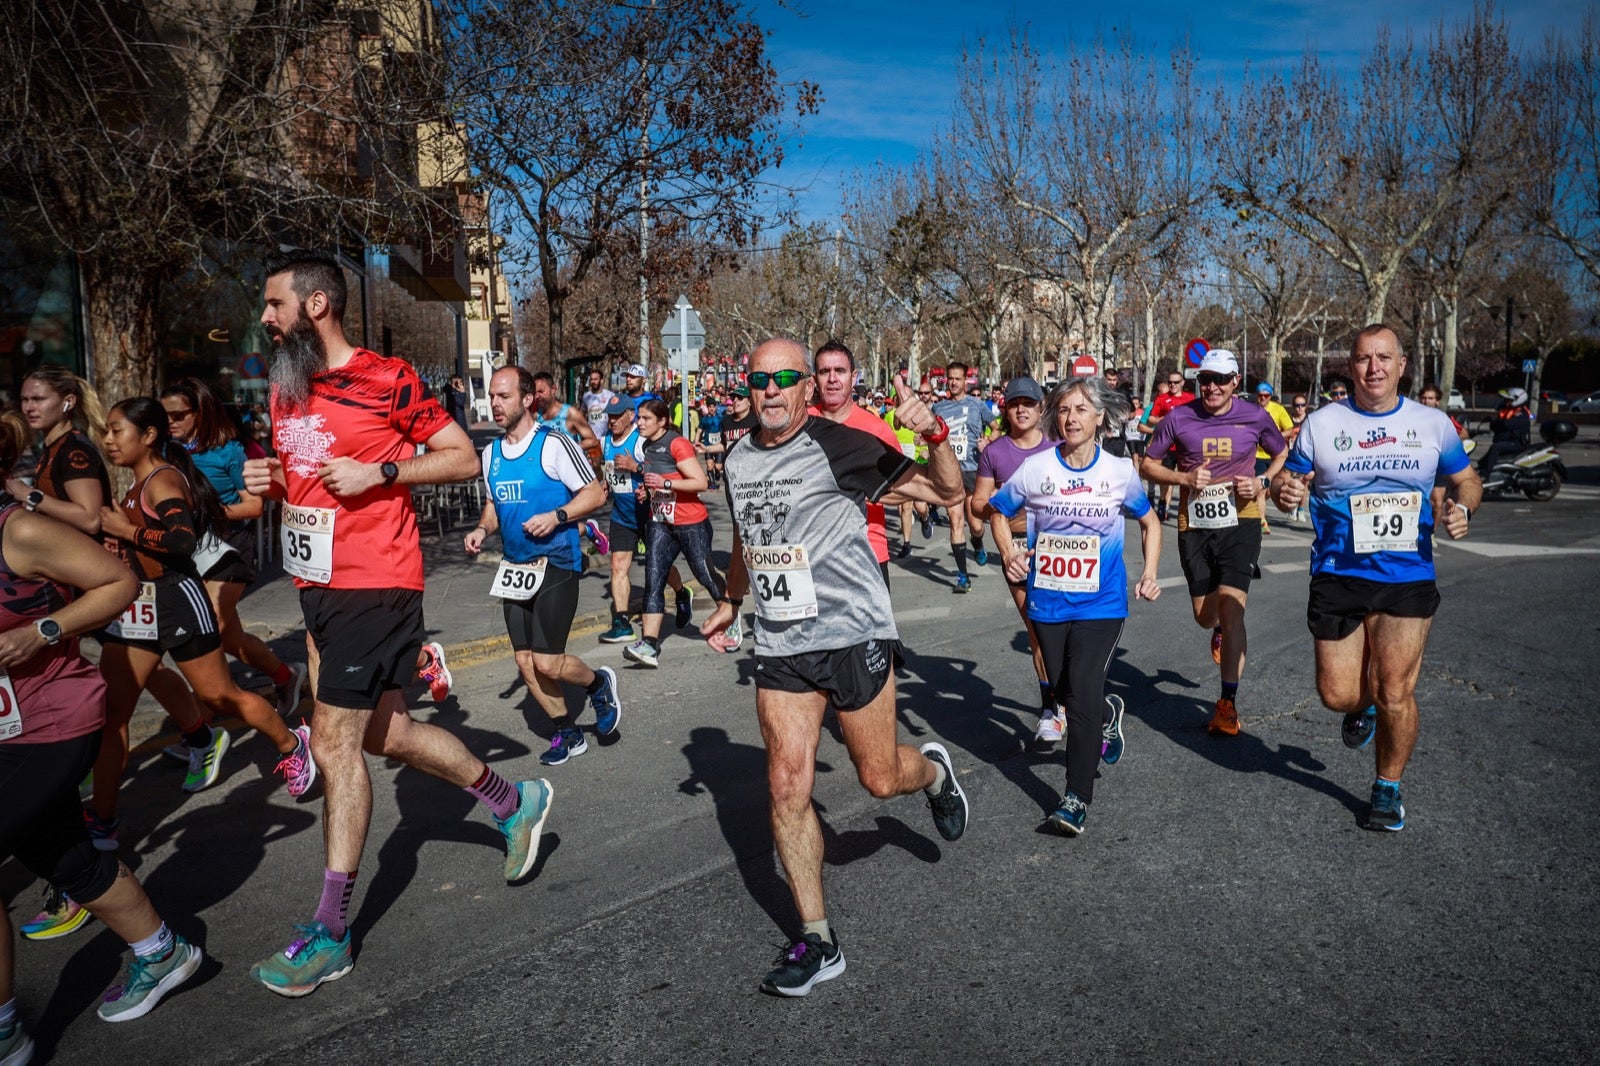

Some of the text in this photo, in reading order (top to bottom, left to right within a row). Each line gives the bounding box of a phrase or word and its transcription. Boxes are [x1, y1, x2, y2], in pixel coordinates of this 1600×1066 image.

[278, 430, 329, 451] carrera
[724, 428, 750, 441] HAMPI
[1203, 438, 1232, 456] CB
[1339, 459, 1420, 472] MARACENA
[764, 480, 774, 488] DE
[1199, 488, 1225, 497] ONDO
[1045, 505, 1109, 518] MARACENA
[1194, 501, 1229, 519] 888
[1366, 497, 1409, 508] FONDO
[1373, 514, 1403, 536] 59
[287, 530, 312, 561] 35
[1050, 539, 1088, 550] FONDO
[1039, 555, 1098, 579] 2007
[502, 569, 537, 590] 530
[757, 574, 792, 602] 34
